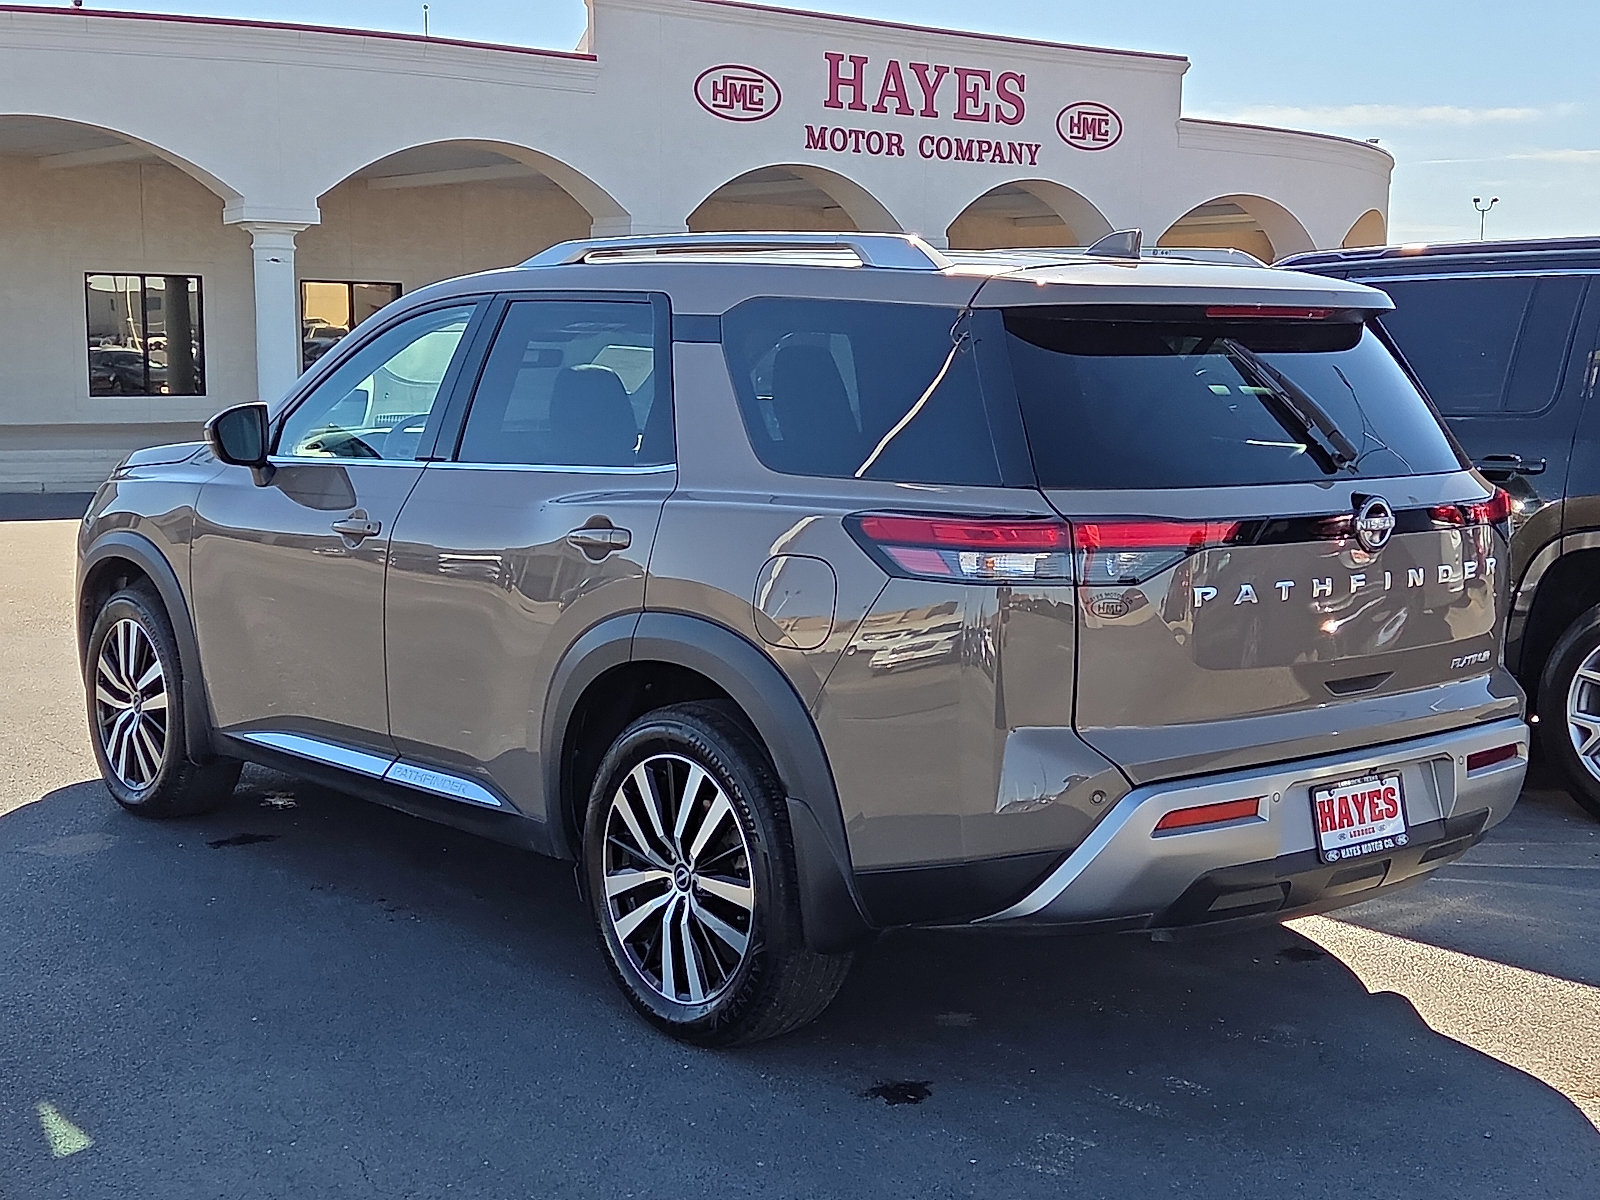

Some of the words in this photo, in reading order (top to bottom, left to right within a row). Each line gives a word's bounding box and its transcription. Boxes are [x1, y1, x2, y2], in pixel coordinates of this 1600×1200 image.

[712, 74, 765, 112] HMC
[823, 52, 1027, 125] HAYES
[804, 124, 905, 157] MOTOR
[918, 135, 1041, 166] COMPANY
[1069, 110, 1110, 142] HMC
[1193, 557, 1498, 609] PATHFINDER
[393, 766, 468, 795] PATHFINDER
[1318, 786, 1399, 833] HAYES
[1340, 845, 1361, 859] HAYES
[1361, 840, 1384, 854] MOTOR
